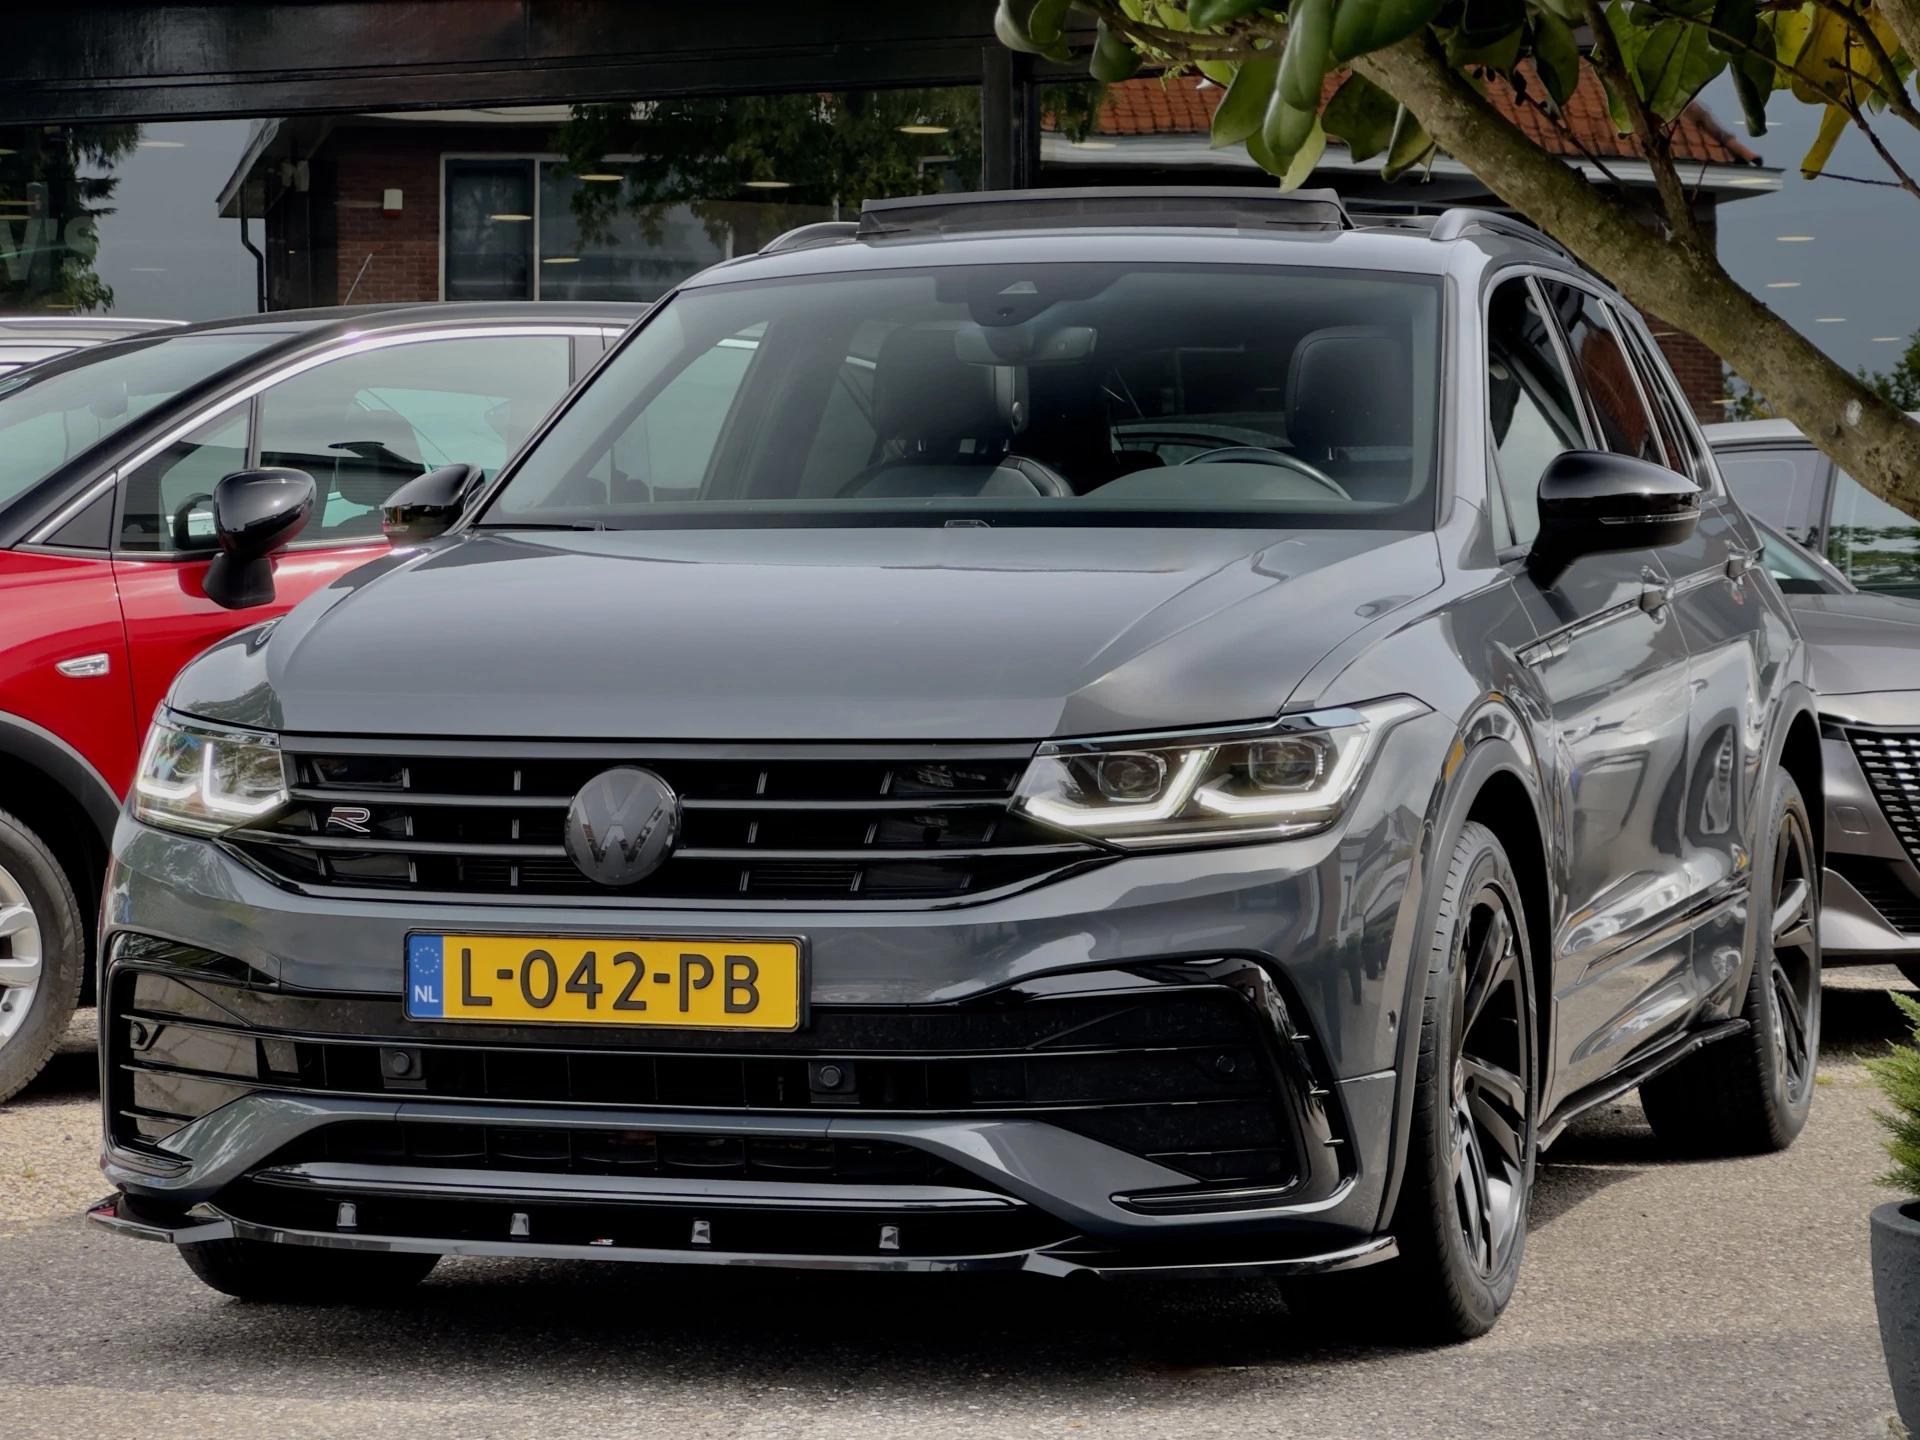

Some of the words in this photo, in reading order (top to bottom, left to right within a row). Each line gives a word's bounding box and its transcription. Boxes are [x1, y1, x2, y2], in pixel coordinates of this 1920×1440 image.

[326, 806, 371, 832] R
[414, 984, 440, 1004] NL
[461, 948, 760, 1014] L-042-PB
